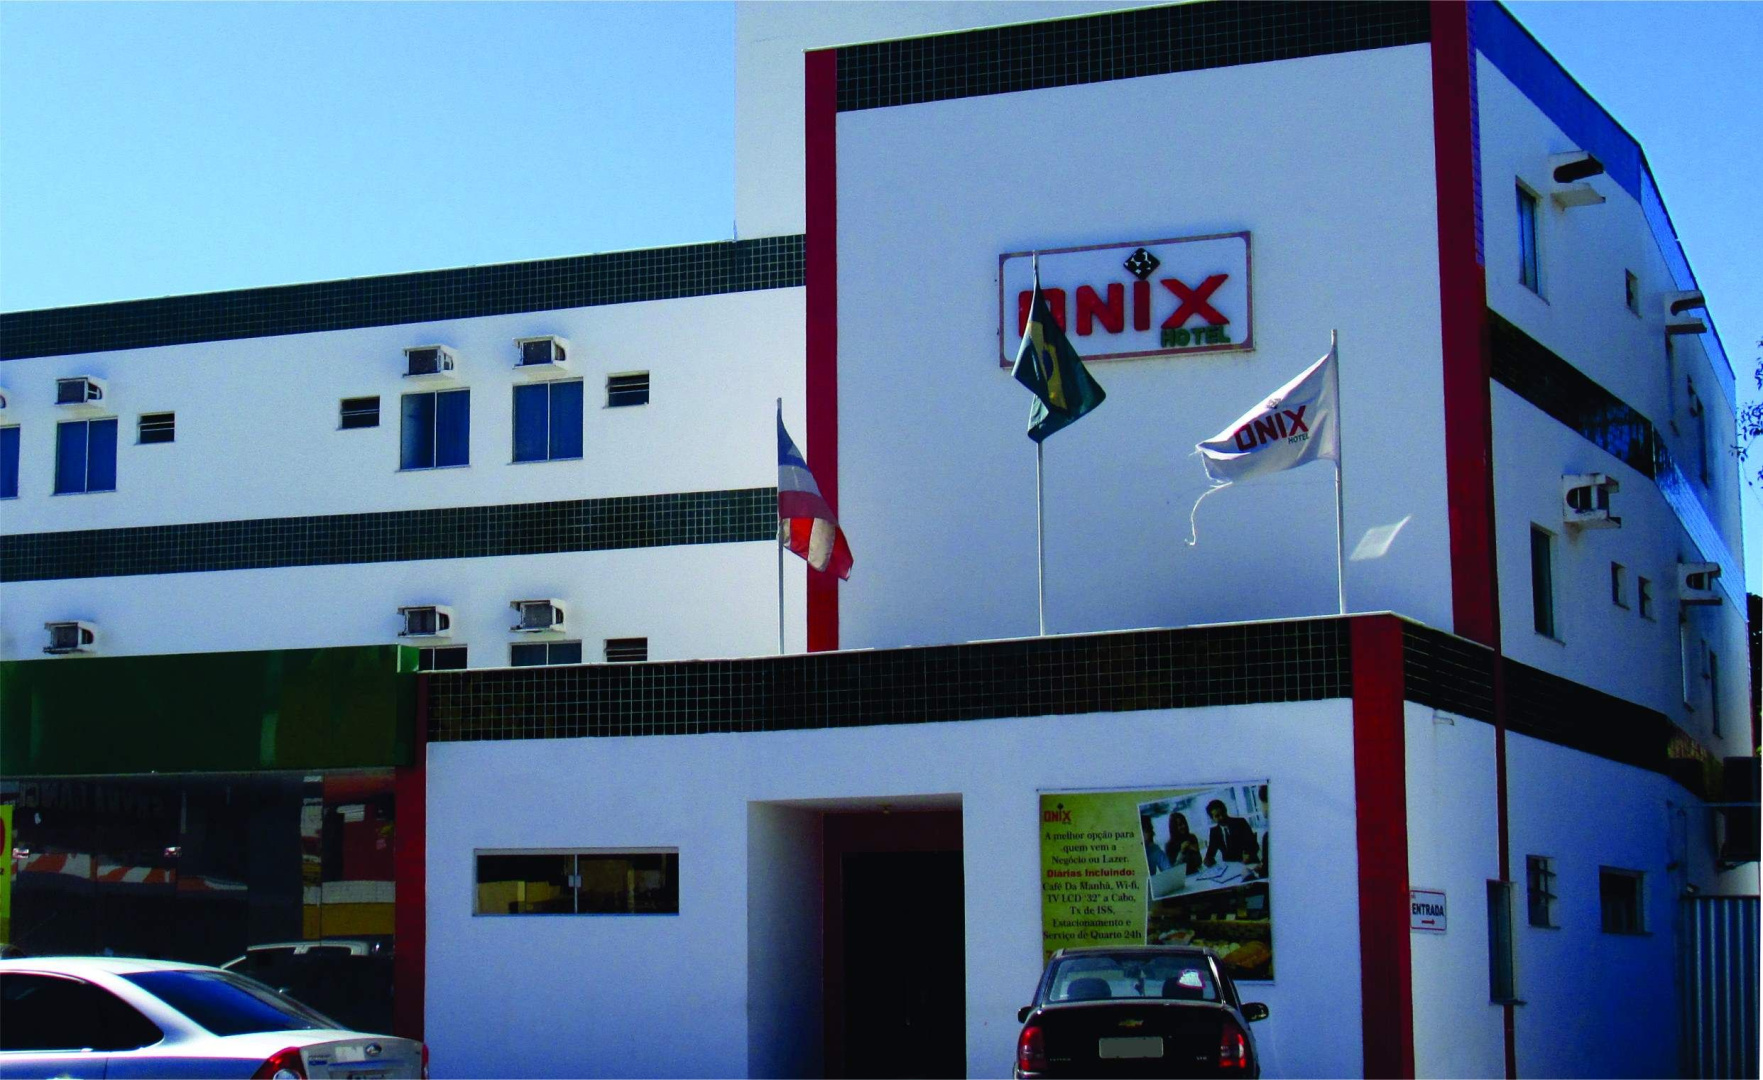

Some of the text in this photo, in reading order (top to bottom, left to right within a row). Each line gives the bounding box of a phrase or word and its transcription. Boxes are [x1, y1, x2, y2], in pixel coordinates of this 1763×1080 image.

[1160, 325, 1231, 348] HOTEL
[1234, 405, 1309, 451] ONIX
[1288, 432, 1310, 445] HOTEL
[1045, 831, 1135, 841] A melhor opção para
[1063, 845, 1088, 854] quem
[1051, 855, 1086, 865] Negócio
[1102, 855, 1129, 864] Lazer.
[1085, 868, 1135, 877] Incluindo:
[1042, 882, 1062, 891] Café
[1065, 882, 1077, 890] Da
[1048, 894, 1060, 902] TV
[1062, 894, 1082, 902] LCD
[1111, 893, 1136, 902] Cabo,
[1070, 906, 1081, 914] Tx
[1084, 906, 1095, 915] de
[1412, 903, 1445, 916] ENTRADA
[1053, 919, 1124, 928] Estacionamento
[1043, 930, 1142, 940] Serviço de Quarto 24h
